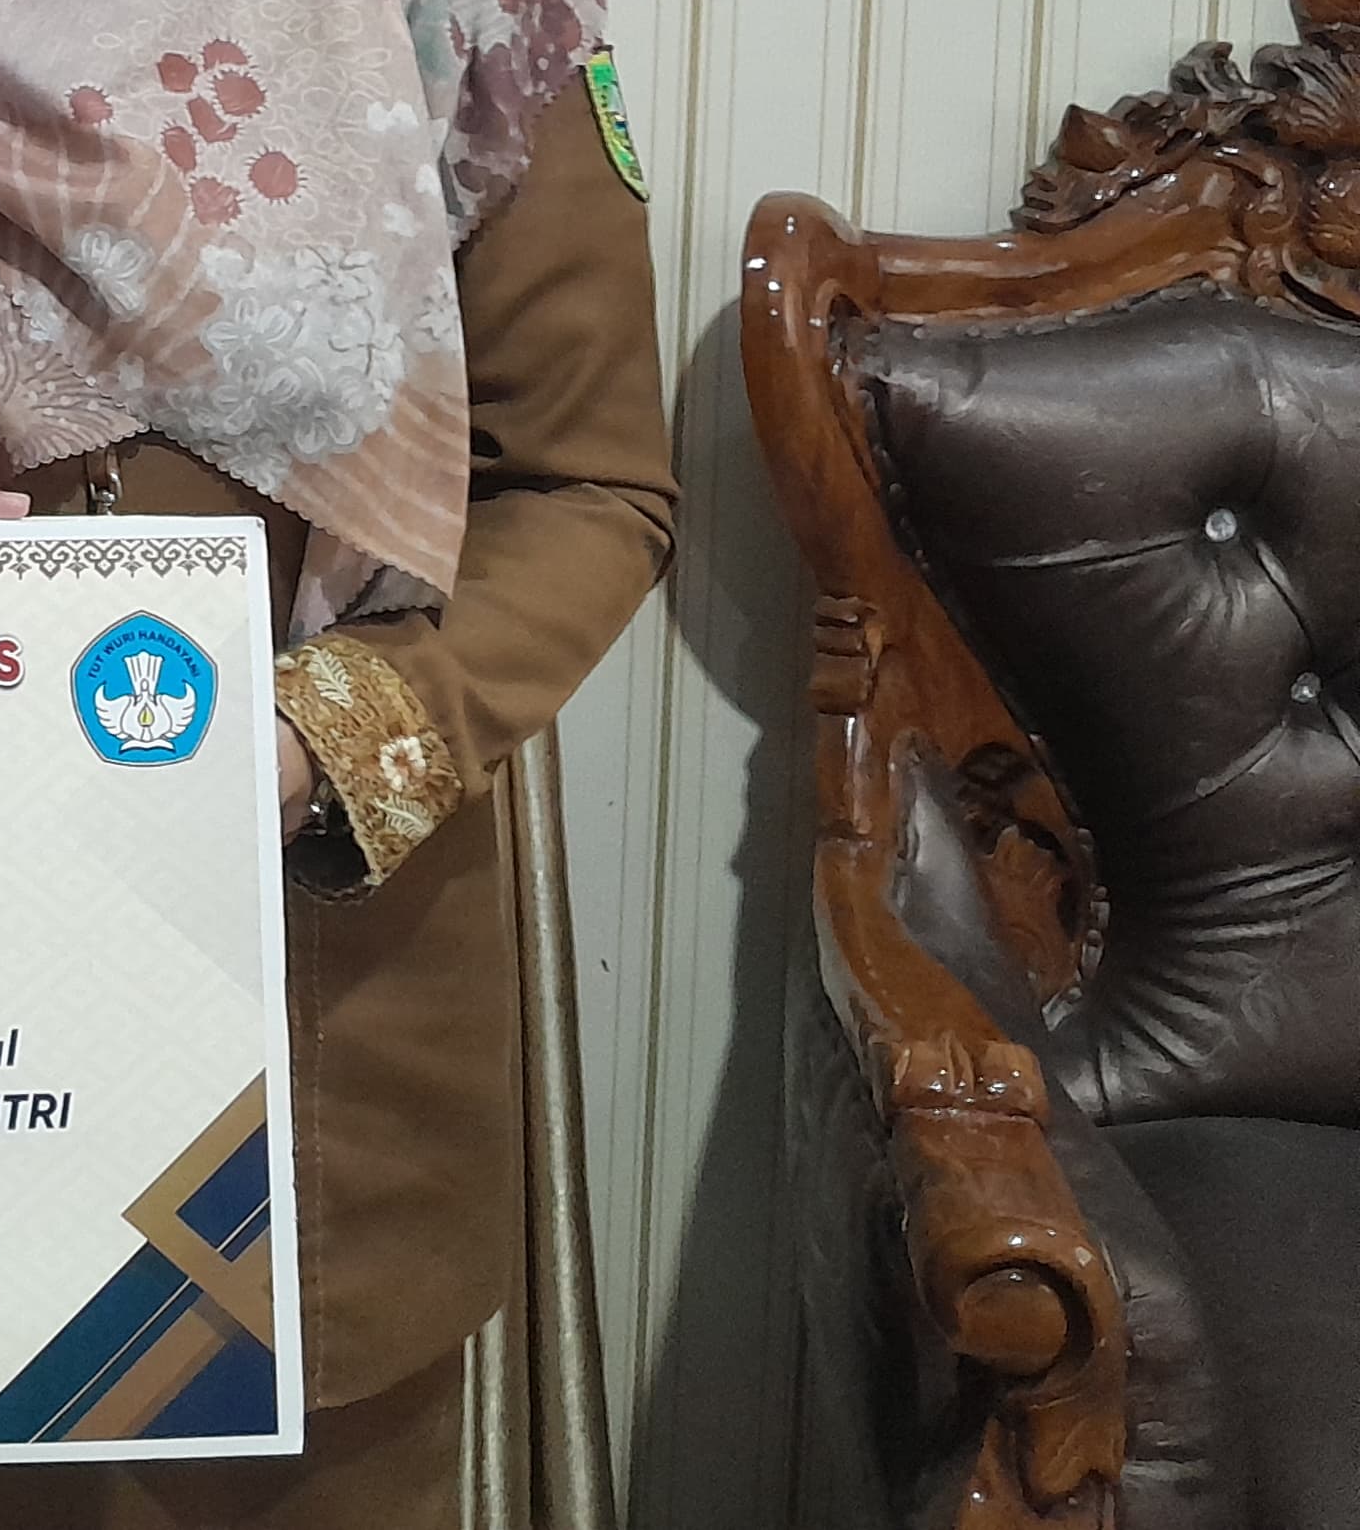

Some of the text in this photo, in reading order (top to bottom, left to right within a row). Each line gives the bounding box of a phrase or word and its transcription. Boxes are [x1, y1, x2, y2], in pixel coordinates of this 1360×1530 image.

[88, 630, 201, 679] TUT WURI HANDAYANI
